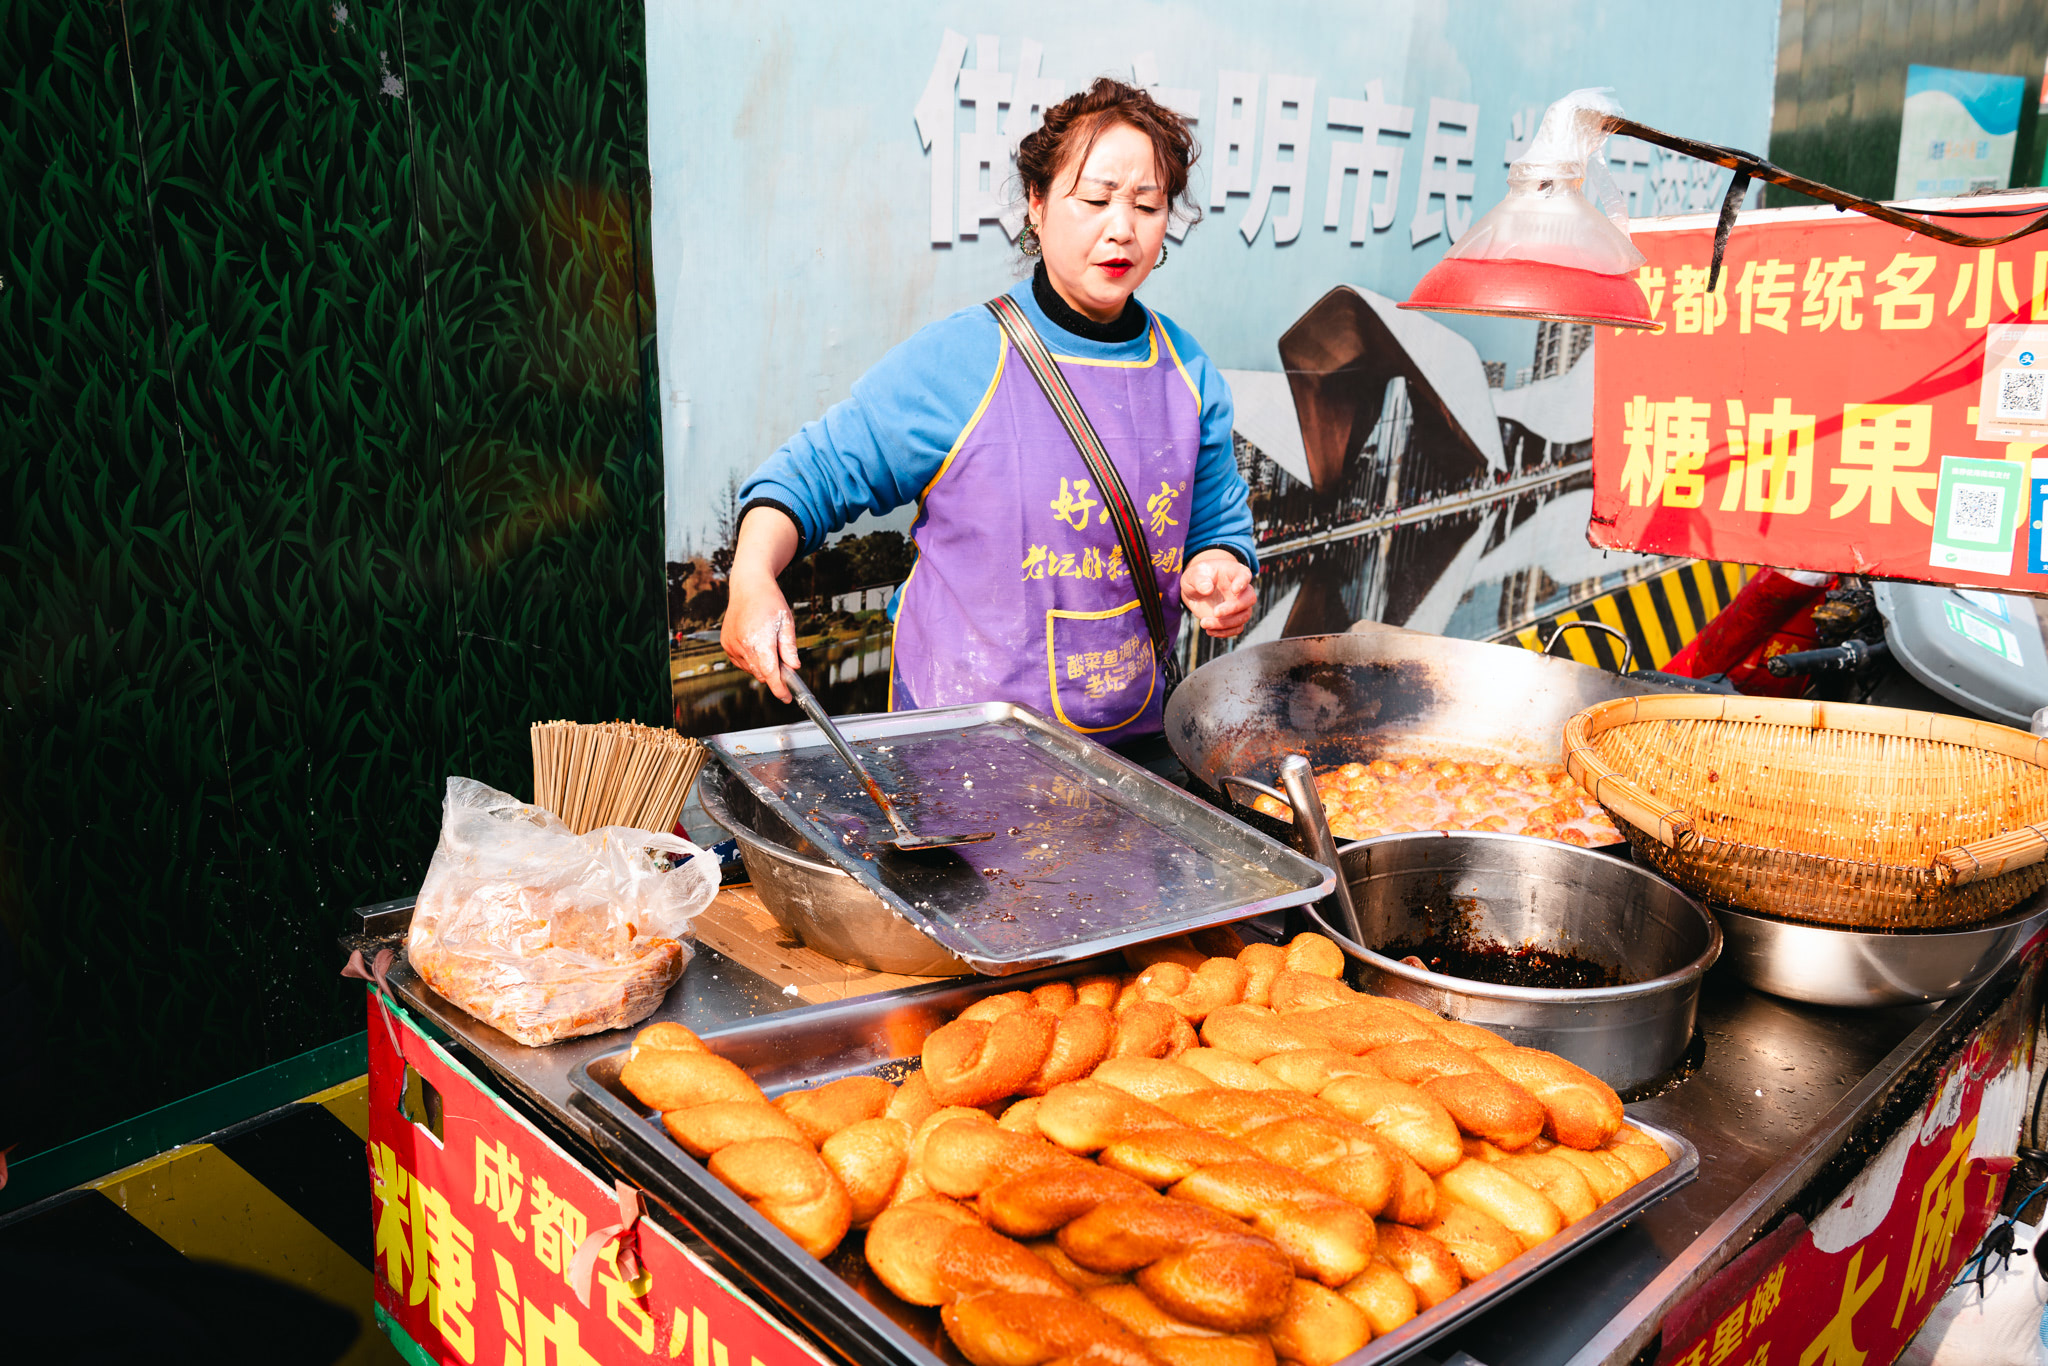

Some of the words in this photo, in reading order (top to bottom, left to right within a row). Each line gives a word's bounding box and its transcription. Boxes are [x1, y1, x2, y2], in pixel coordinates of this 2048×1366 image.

[914, 28, 1480, 249] 做明市民
[1021, 544, 1184, 581] 老坛酸菜调
[1050, 477, 1179, 537] 好家
[1066, 633, 1140, 680] 酸菜鱼调料
[474, 1135, 767, 1366] 成都名小
[1799, 1114, 1997, 1366] 大麻
